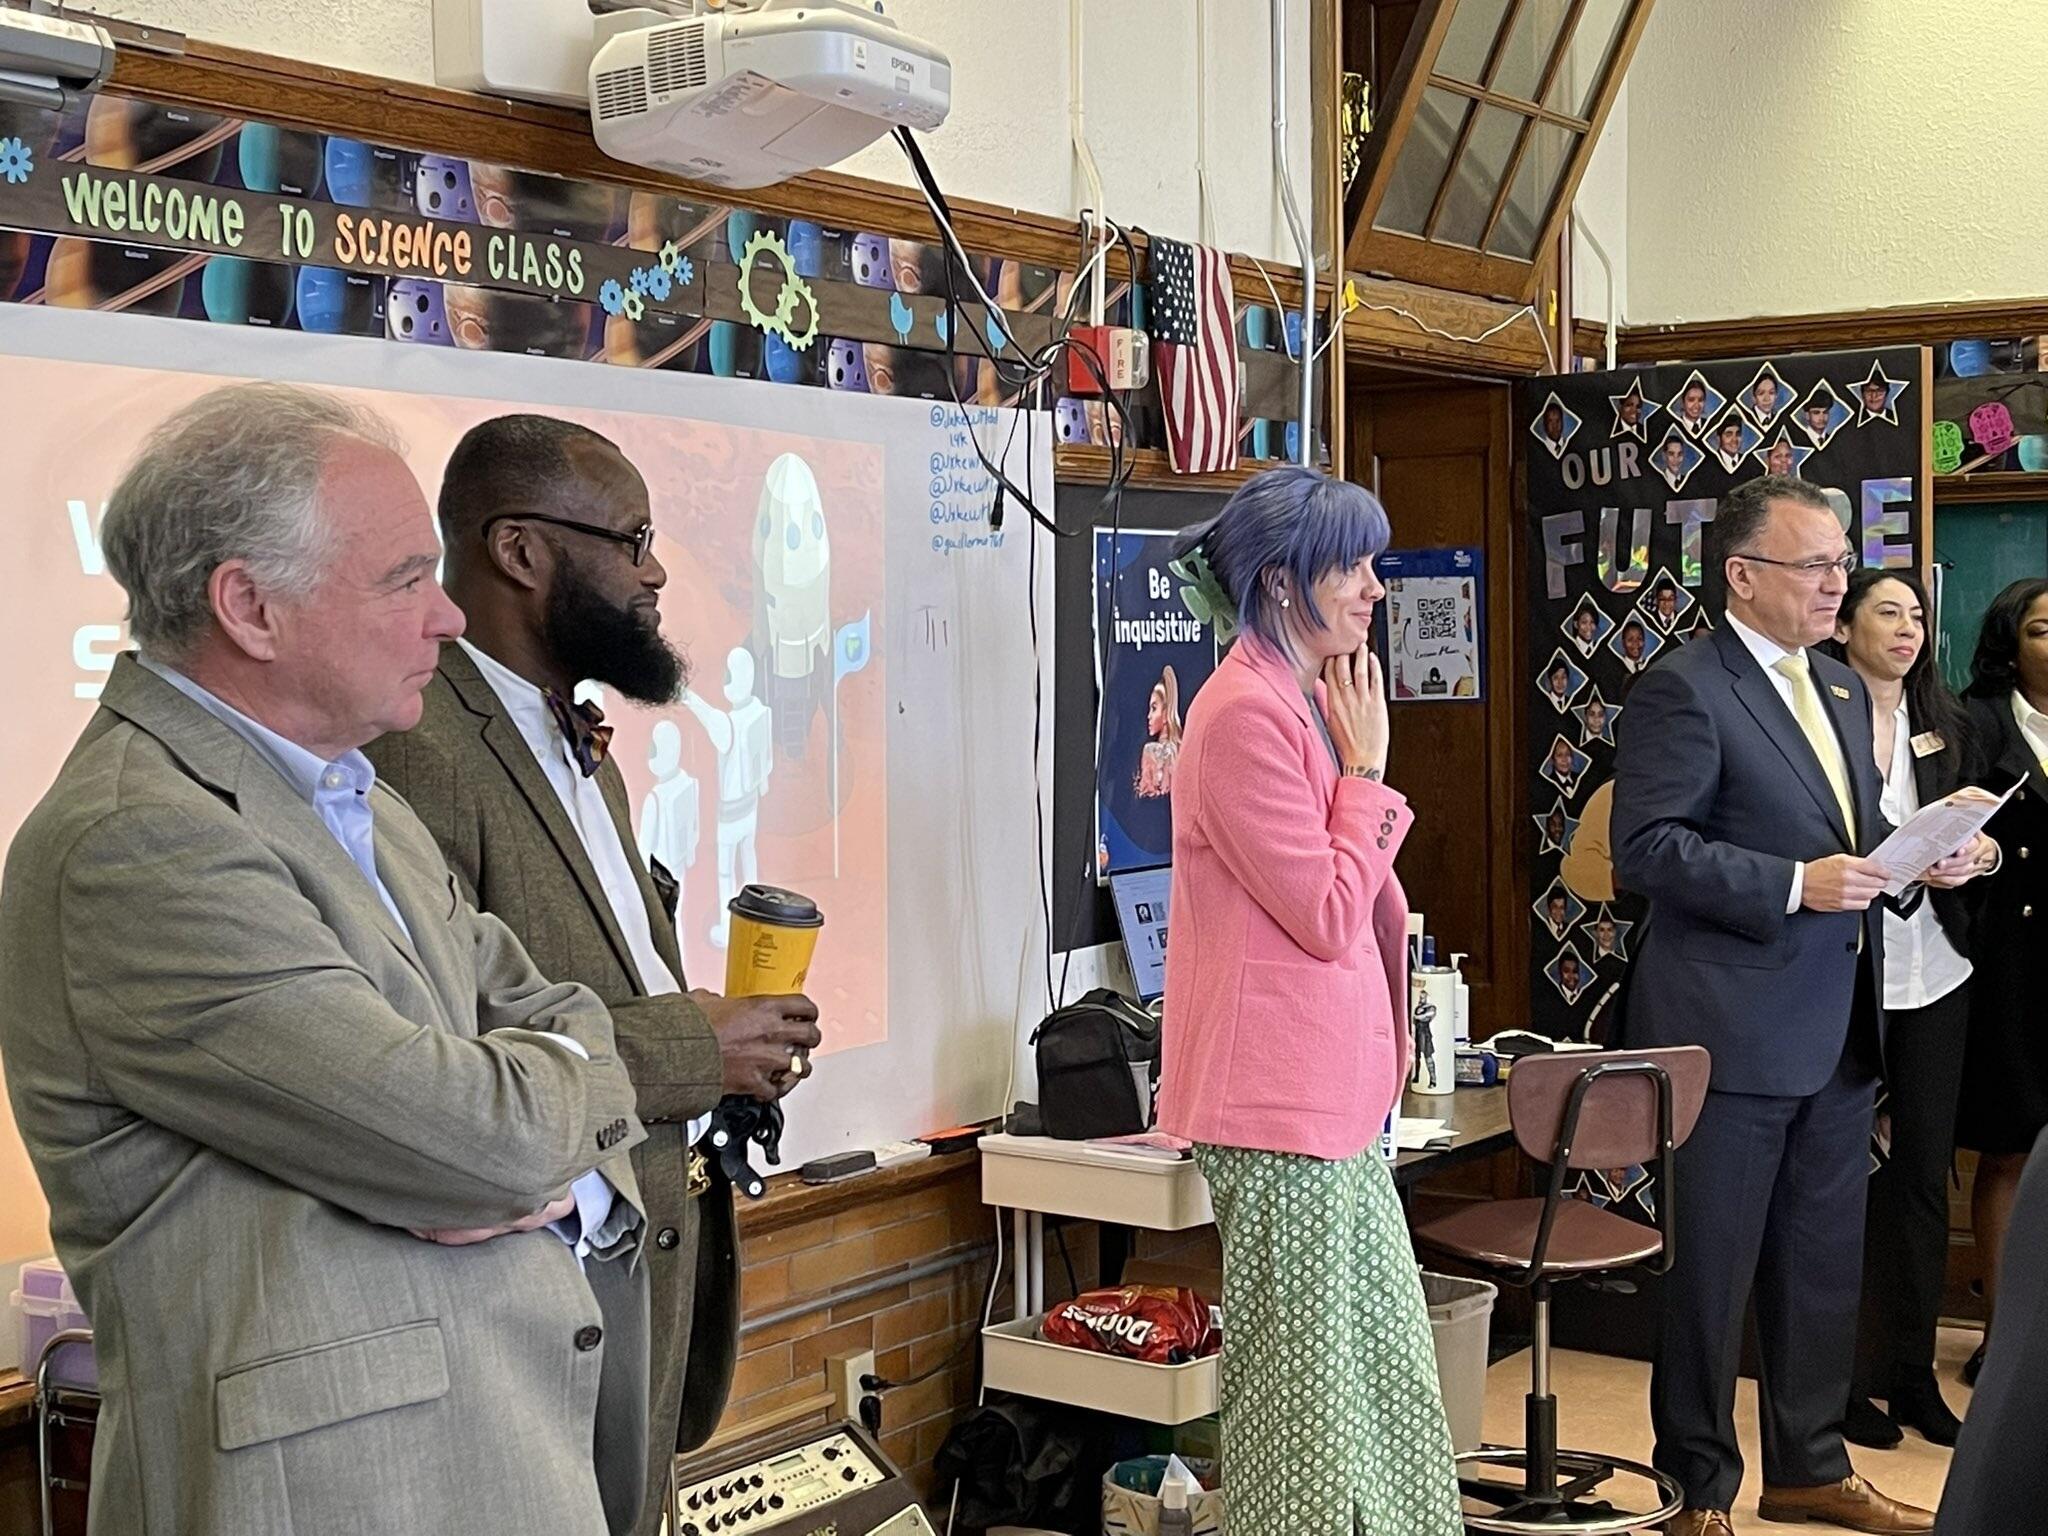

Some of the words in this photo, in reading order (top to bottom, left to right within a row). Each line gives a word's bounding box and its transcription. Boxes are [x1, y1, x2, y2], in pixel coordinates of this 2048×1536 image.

[891, 57, 915, 75] EPSON
[279, 203, 315, 258] TO
[488, 234, 585, 295] CLASS
[1116, 338, 1125, 380] FIRE
[1561, 441, 1642, 490] OUR
[1541, 476, 1913, 600] FUTE
[1148, 567, 1170, 600] Be
[1114, 611, 1202, 651] inquisitive
